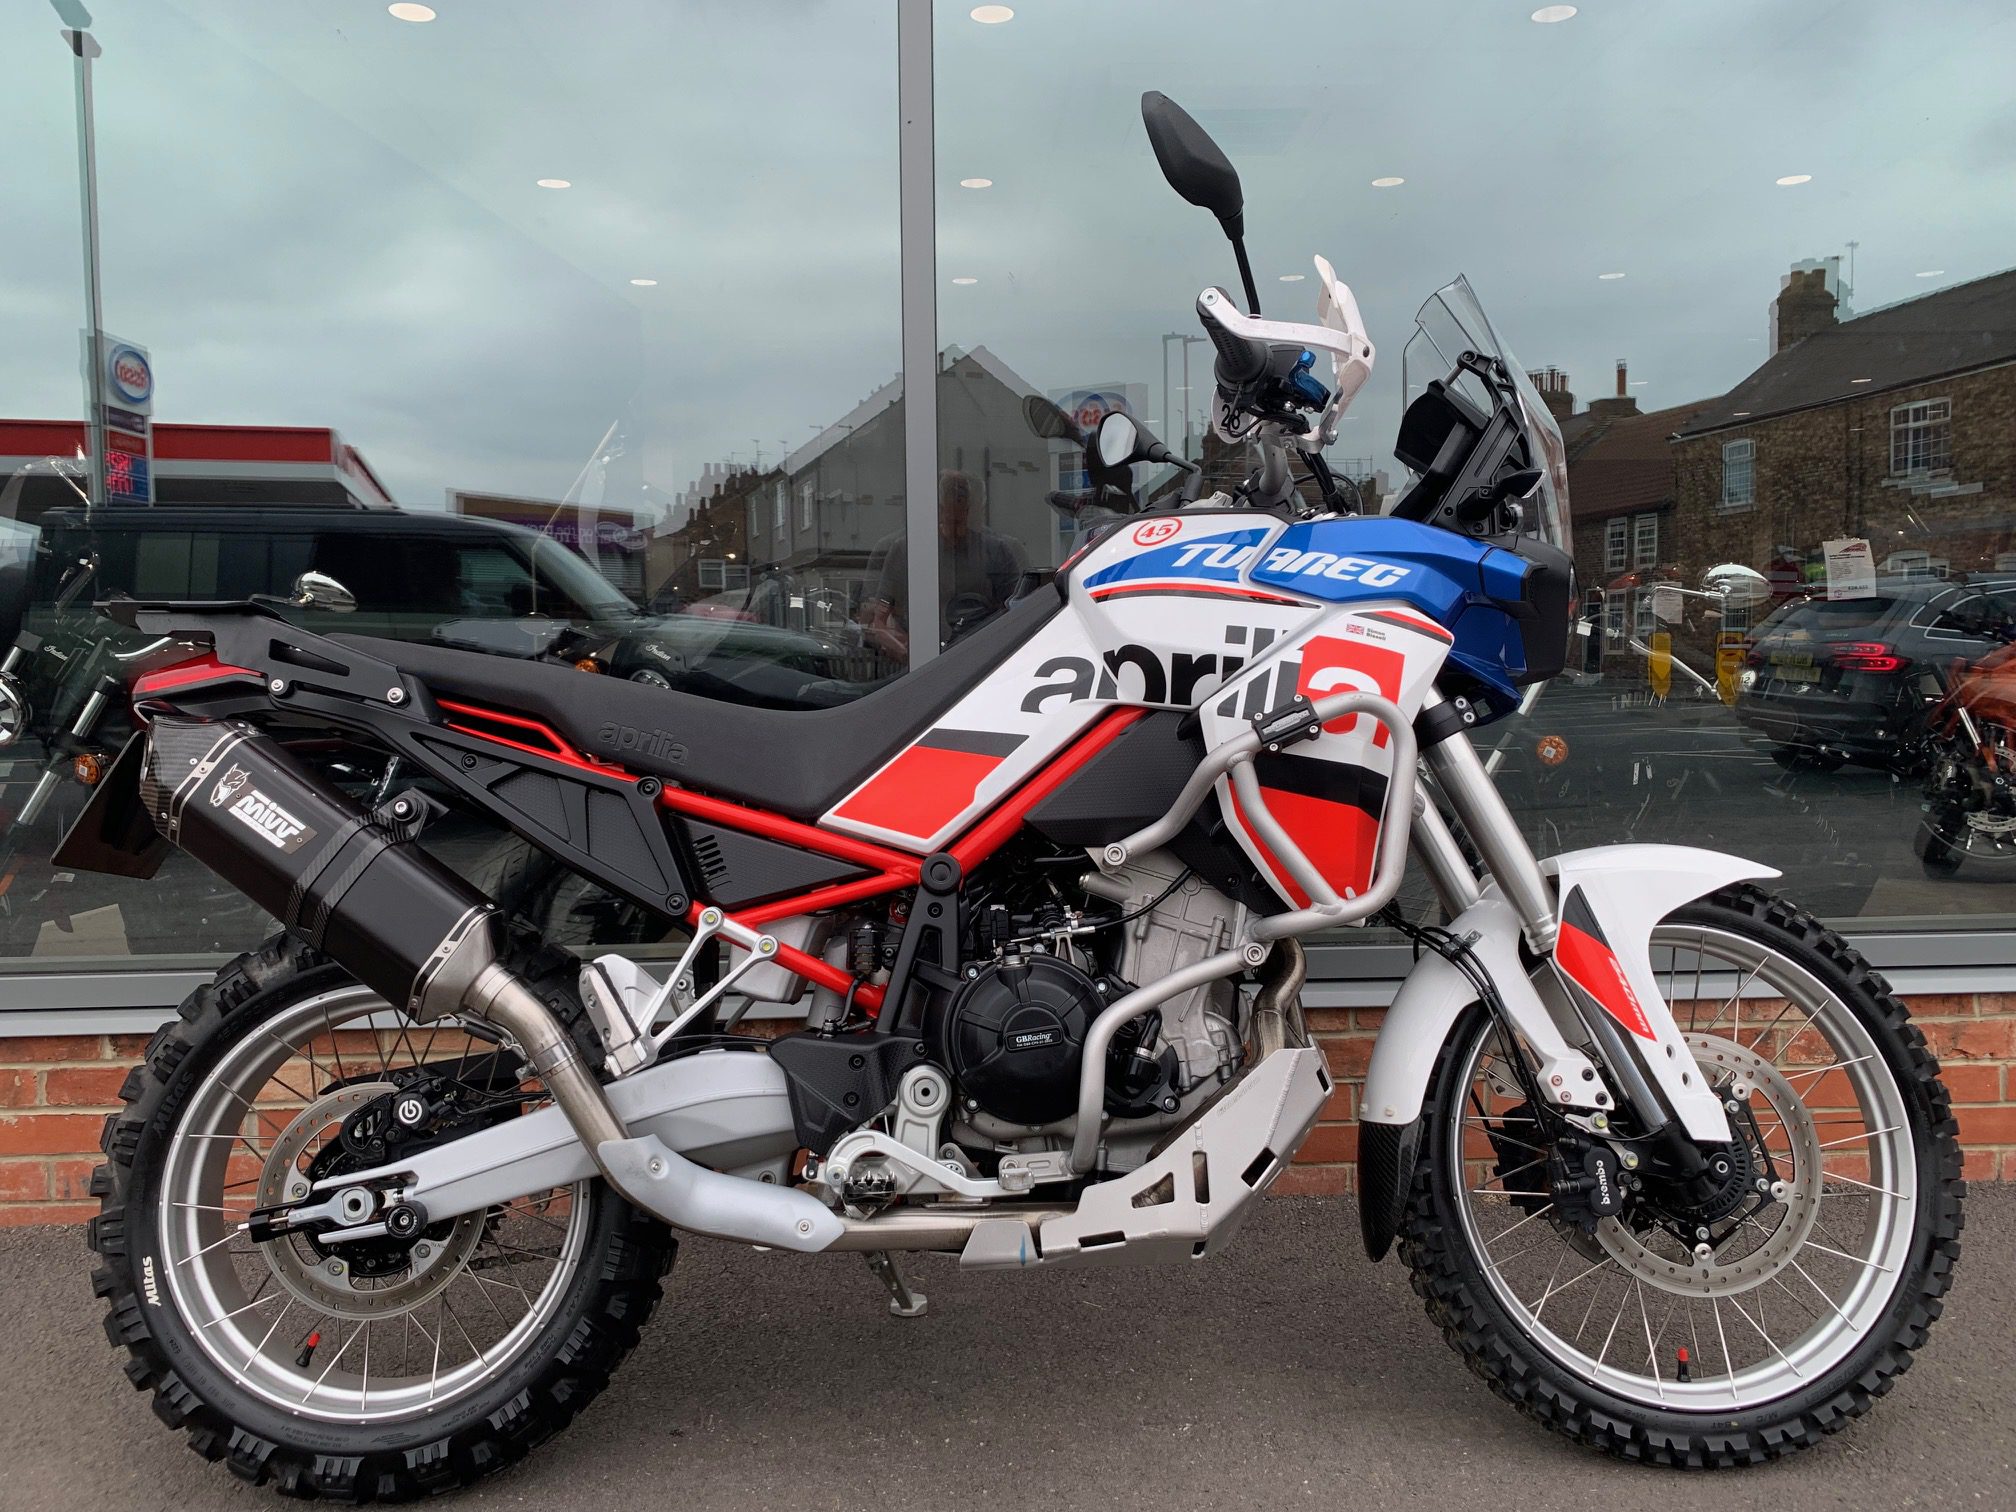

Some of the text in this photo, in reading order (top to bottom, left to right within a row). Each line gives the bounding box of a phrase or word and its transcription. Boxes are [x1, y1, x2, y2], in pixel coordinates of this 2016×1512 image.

[1140, 523, 1173, 538] 45
[1171, 543, 1411, 588] TUAREG
[645, 643, 672, 661] Indian
[1020, 624, 1404, 750] aprilia
[600, 720, 689, 766] aprilia
[1015, 1032, 1052, 1044] GBRacing
[1595, 1159, 1611, 1205] brembo
[142, 1255, 162, 1307] Mitas
